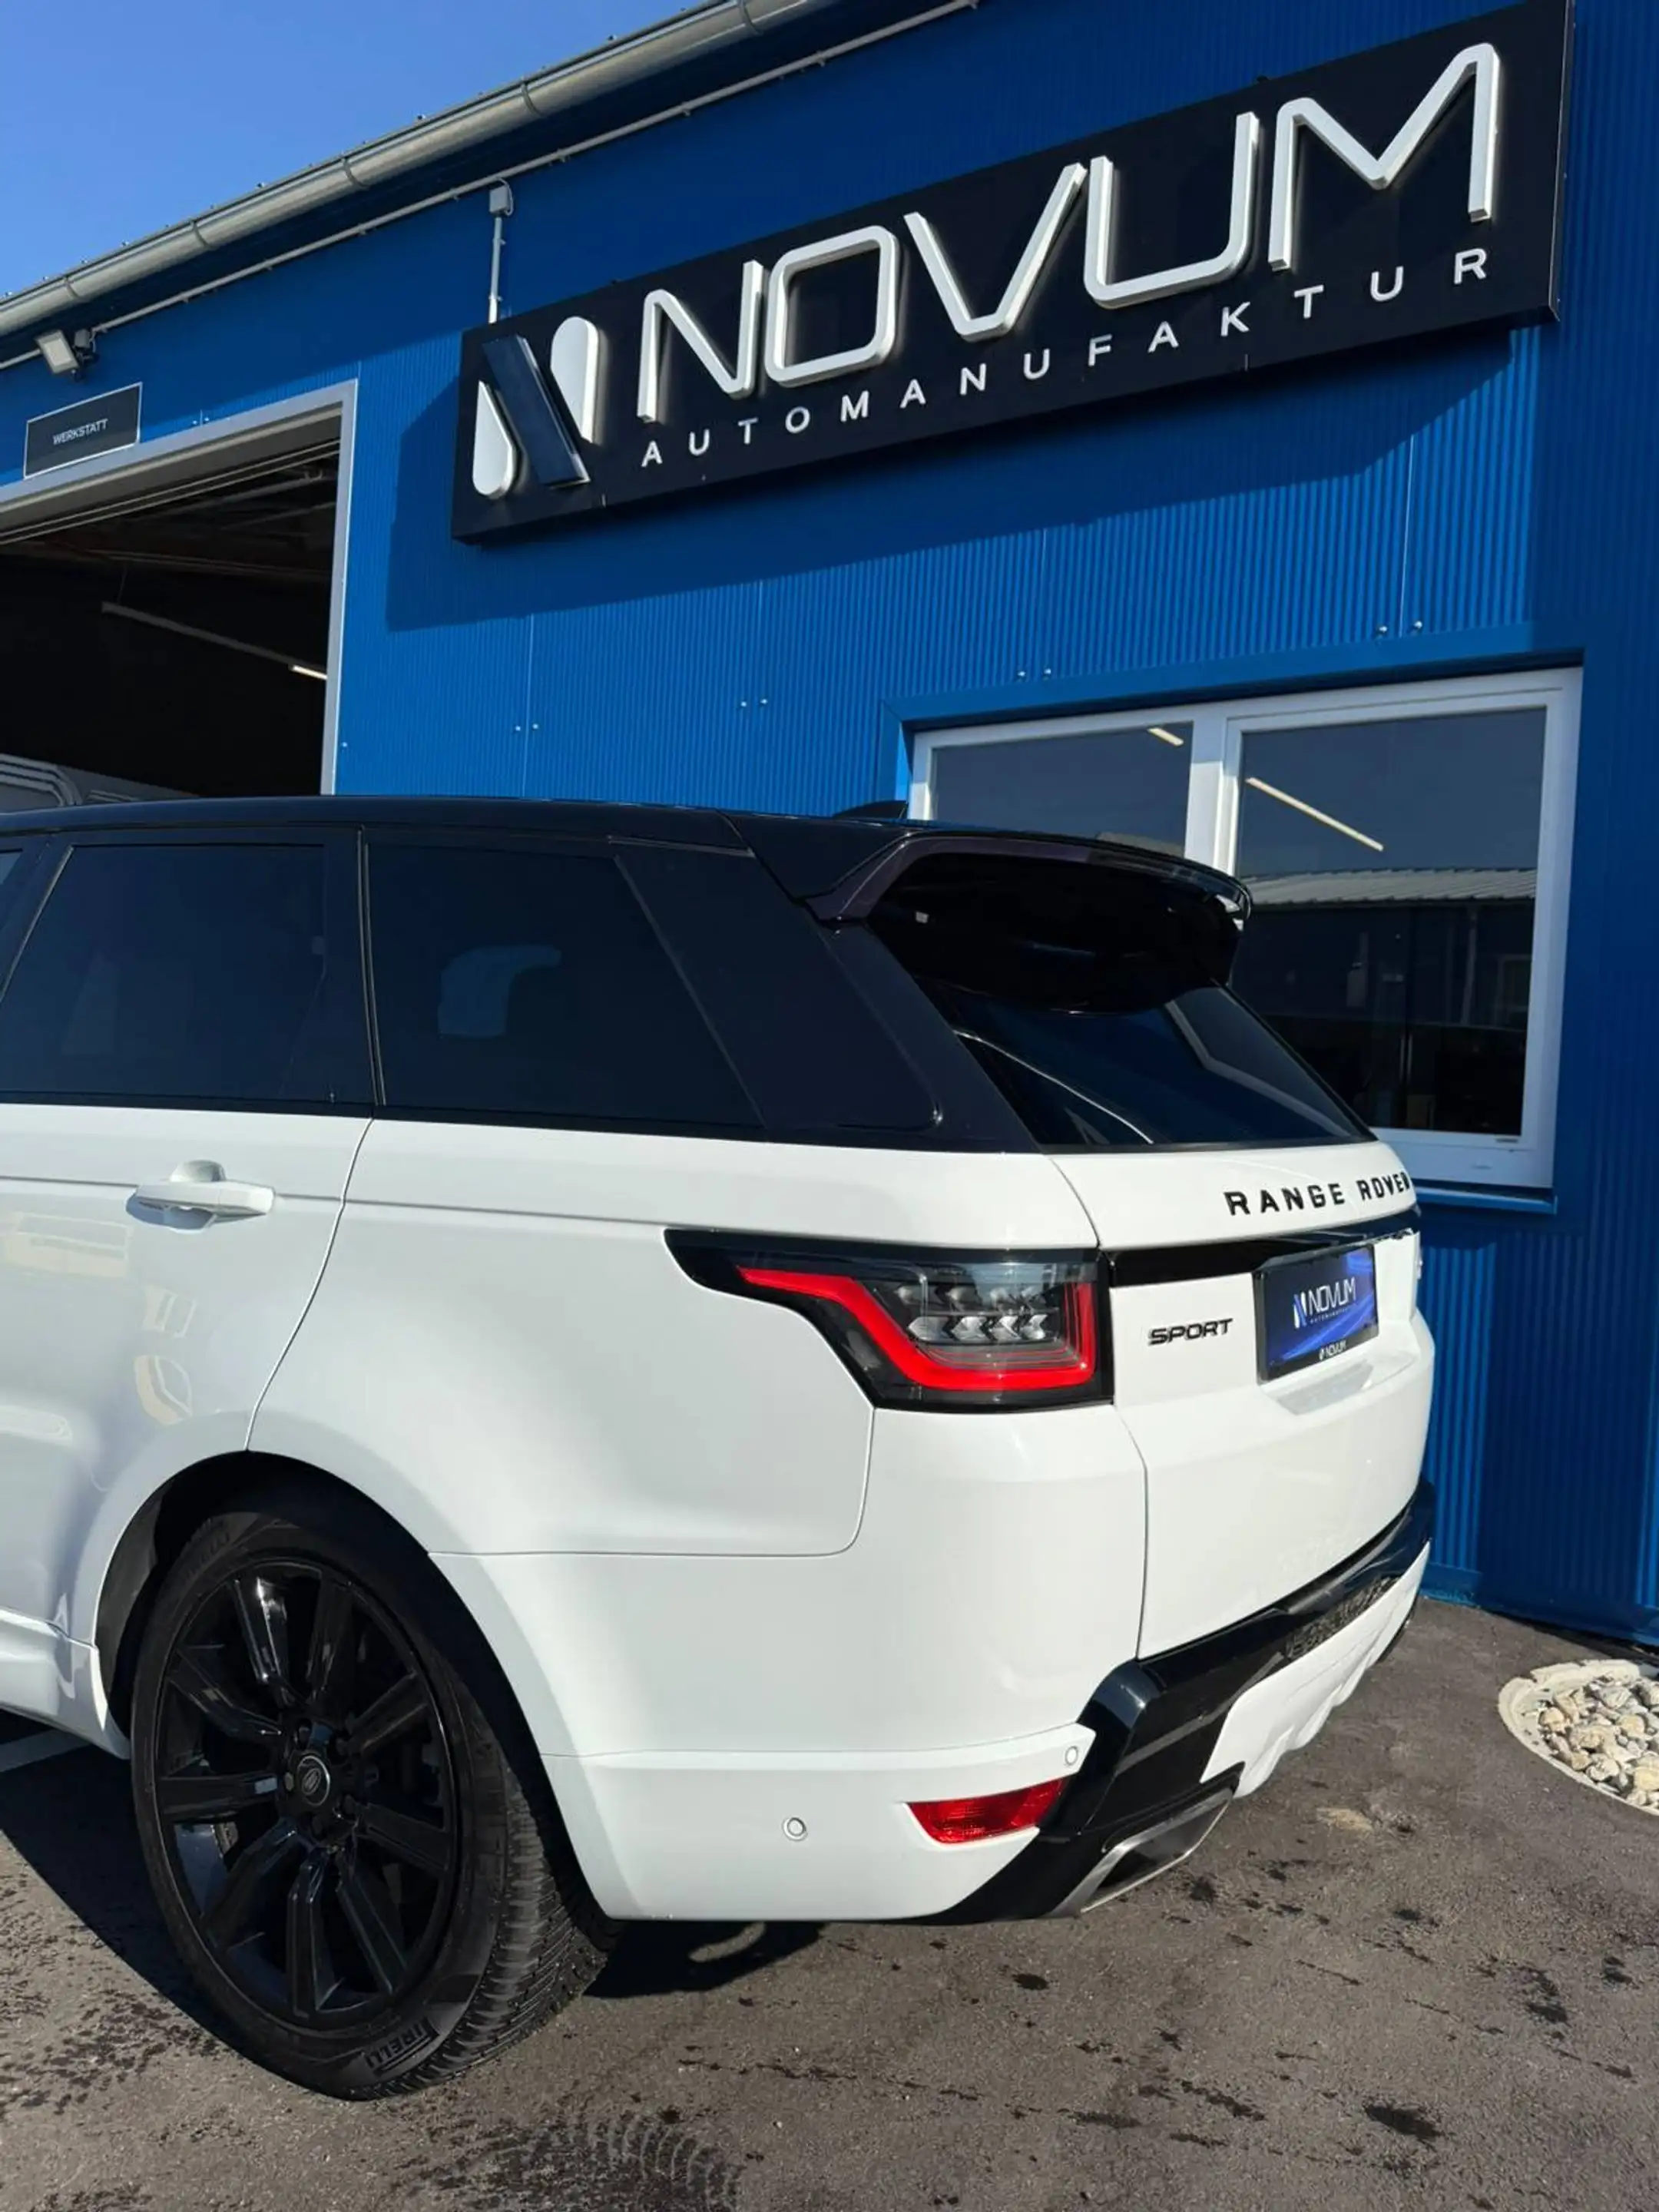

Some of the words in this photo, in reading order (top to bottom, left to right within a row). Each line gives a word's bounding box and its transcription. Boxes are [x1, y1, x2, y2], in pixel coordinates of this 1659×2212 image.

[637, 42, 1501, 422] NOVUM
[641, 247, 1488, 467] AUTOMANUFAKTUR
[52, 418, 108, 445] WERKSTATT
[1224, 1183, 1346, 1216] RANGE
[1308, 1277, 1356, 1316] NOVUM
[1148, 1318, 1233, 1346] SPORT
